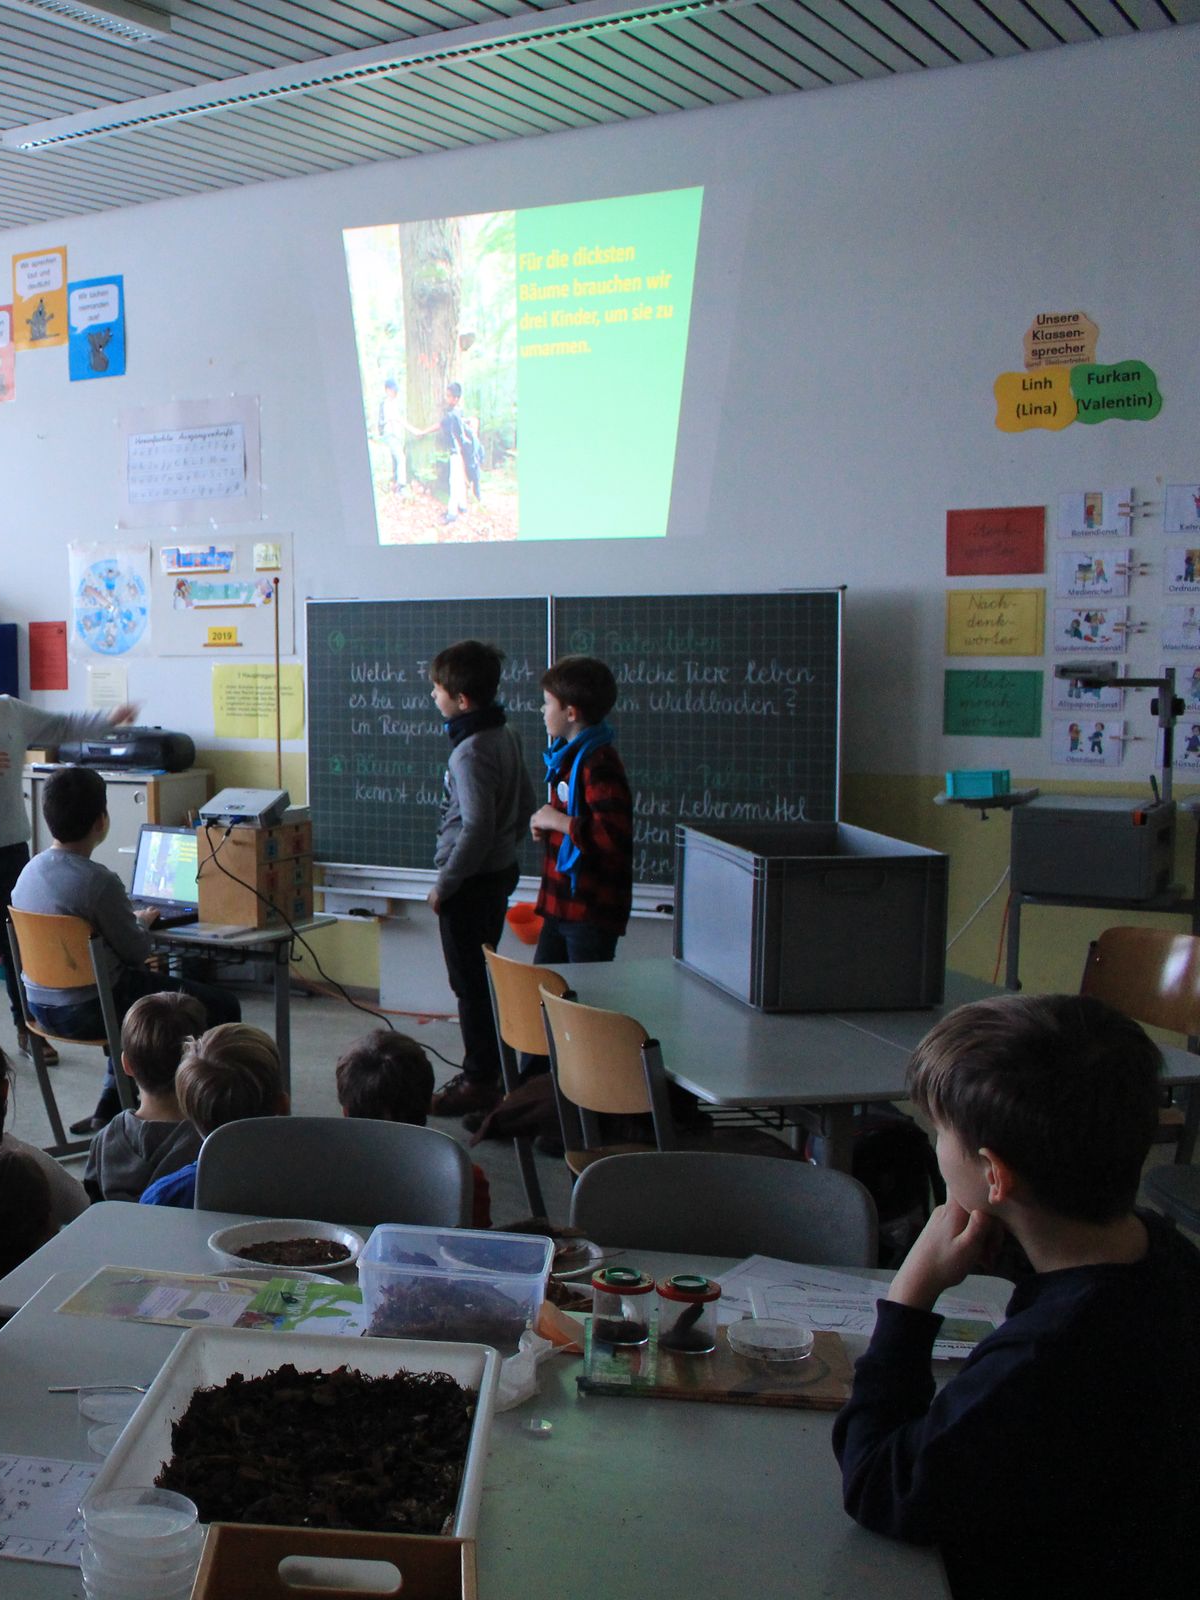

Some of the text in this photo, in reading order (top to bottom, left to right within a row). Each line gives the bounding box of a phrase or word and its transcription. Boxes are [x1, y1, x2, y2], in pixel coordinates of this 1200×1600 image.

[519, 245, 635, 272] Für die dicksten
[519, 271, 673, 303] Bäume brauchen wir
[520, 304, 674, 331] drei Kinder, um sie zu
[1036, 313, 1080, 325] Unsere
[1032, 329, 1086, 341] Klassen-
[520, 339, 592, 358] umarmen.
[1031, 343, 1086, 359] sprecher
[1022, 376, 1053, 392] Linh
[1087, 369, 1141, 385] Furkan
[1016, 401, 1057, 419] (Lina)
[1076, 393, 1153, 414] (Valentin)
[211, 631, 233, 641] 2019
[350, 661, 407, 683] Welche
[500, 658, 535, 682] ibt
[682, 660, 731, 685] Tiere
[744, 657, 816, 686] leben
[349, 692, 367, 709] es
[632, 788, 813, 823] lche Lebensmittel
